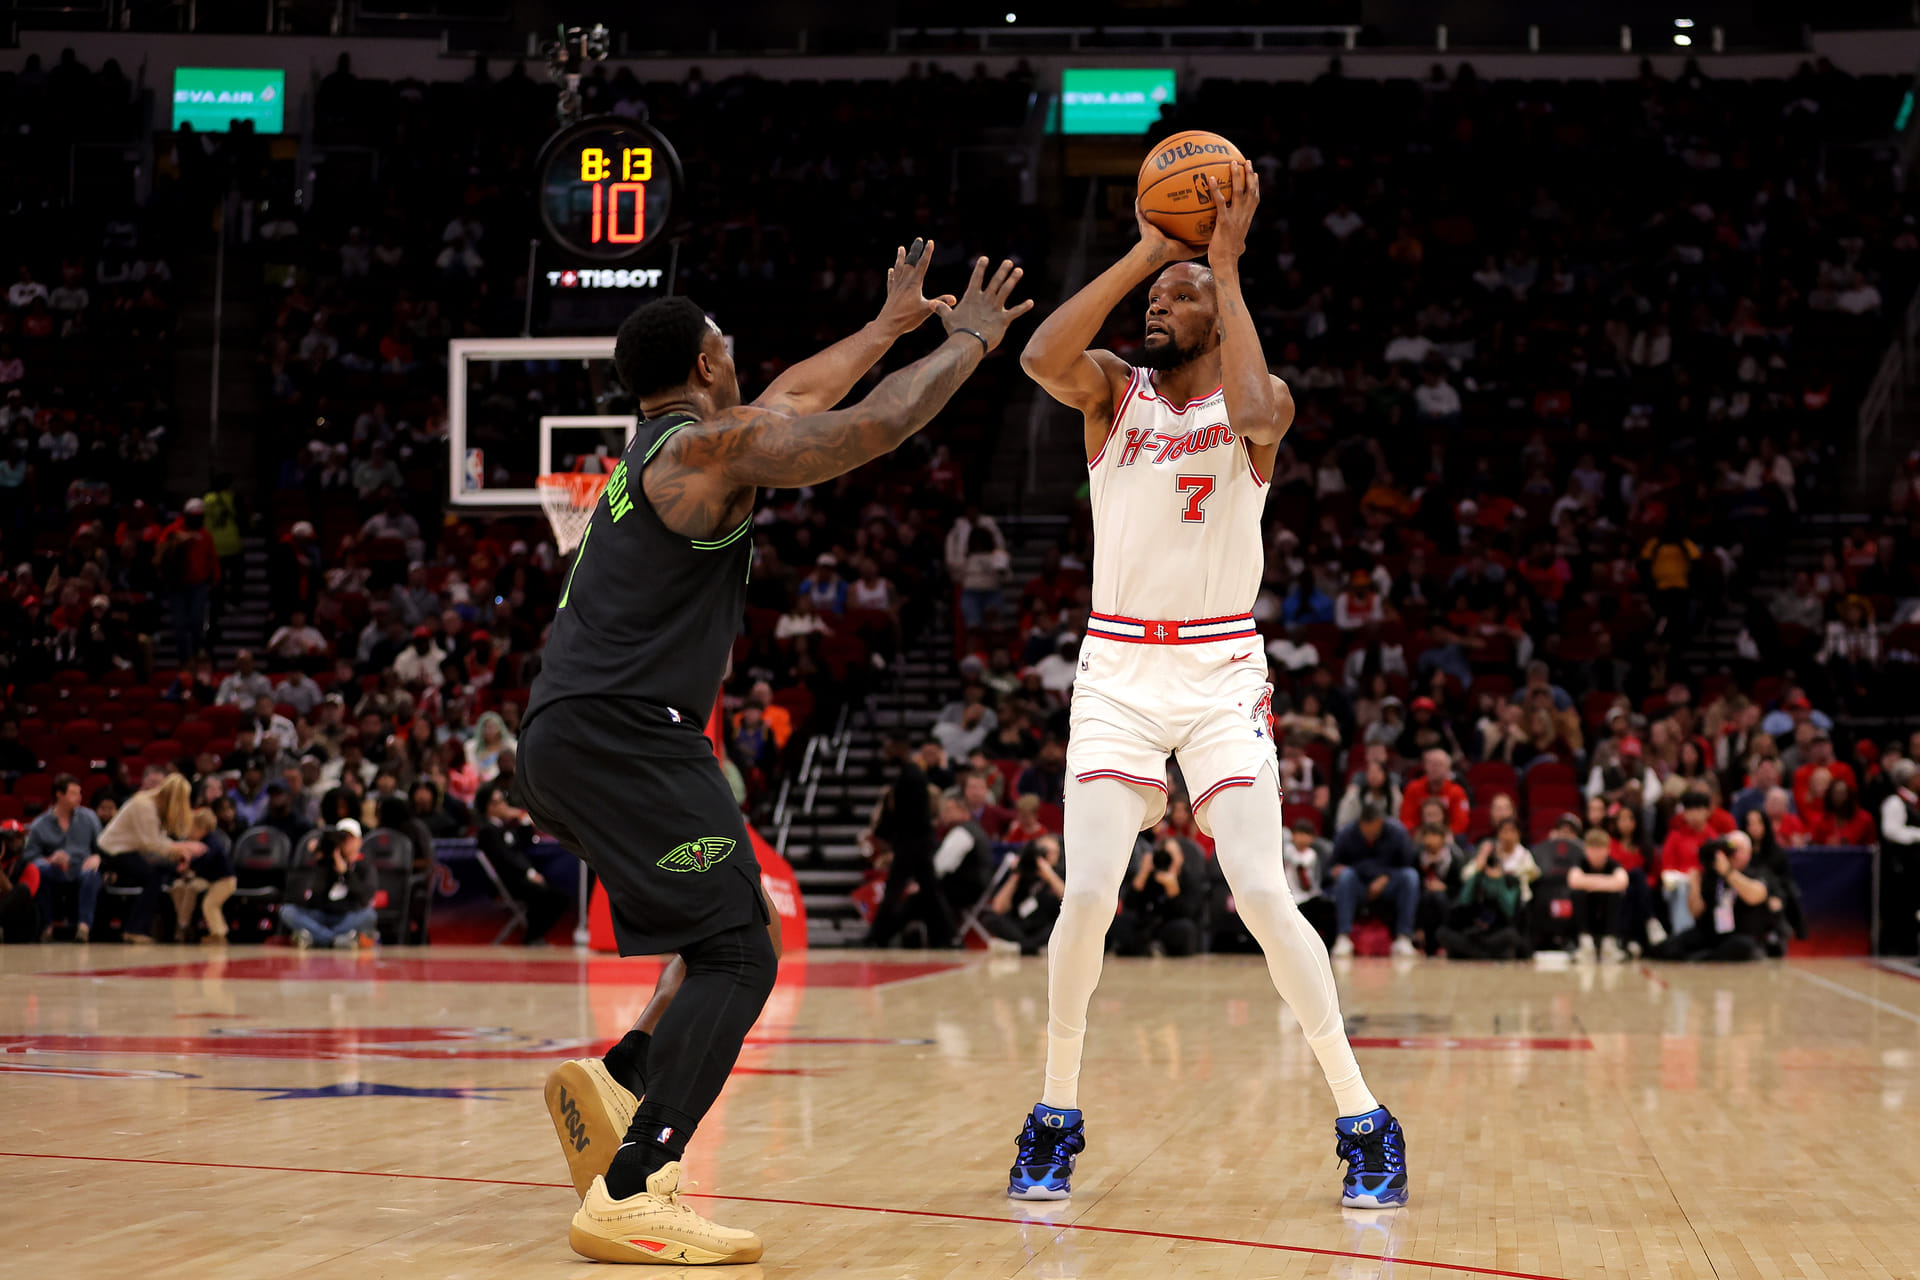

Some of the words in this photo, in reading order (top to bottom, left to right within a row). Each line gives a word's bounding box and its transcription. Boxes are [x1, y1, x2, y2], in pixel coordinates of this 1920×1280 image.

[581, 147, 653, 182] 8:13
[1155, 141, 1231, 170] Wilson
[591, 182, 645, 244] 10
[577, 269, 662, 288] TISSOT
[1117, 422, 1235, 468] H-Town
[1176, 474, 1216, 523] 7
